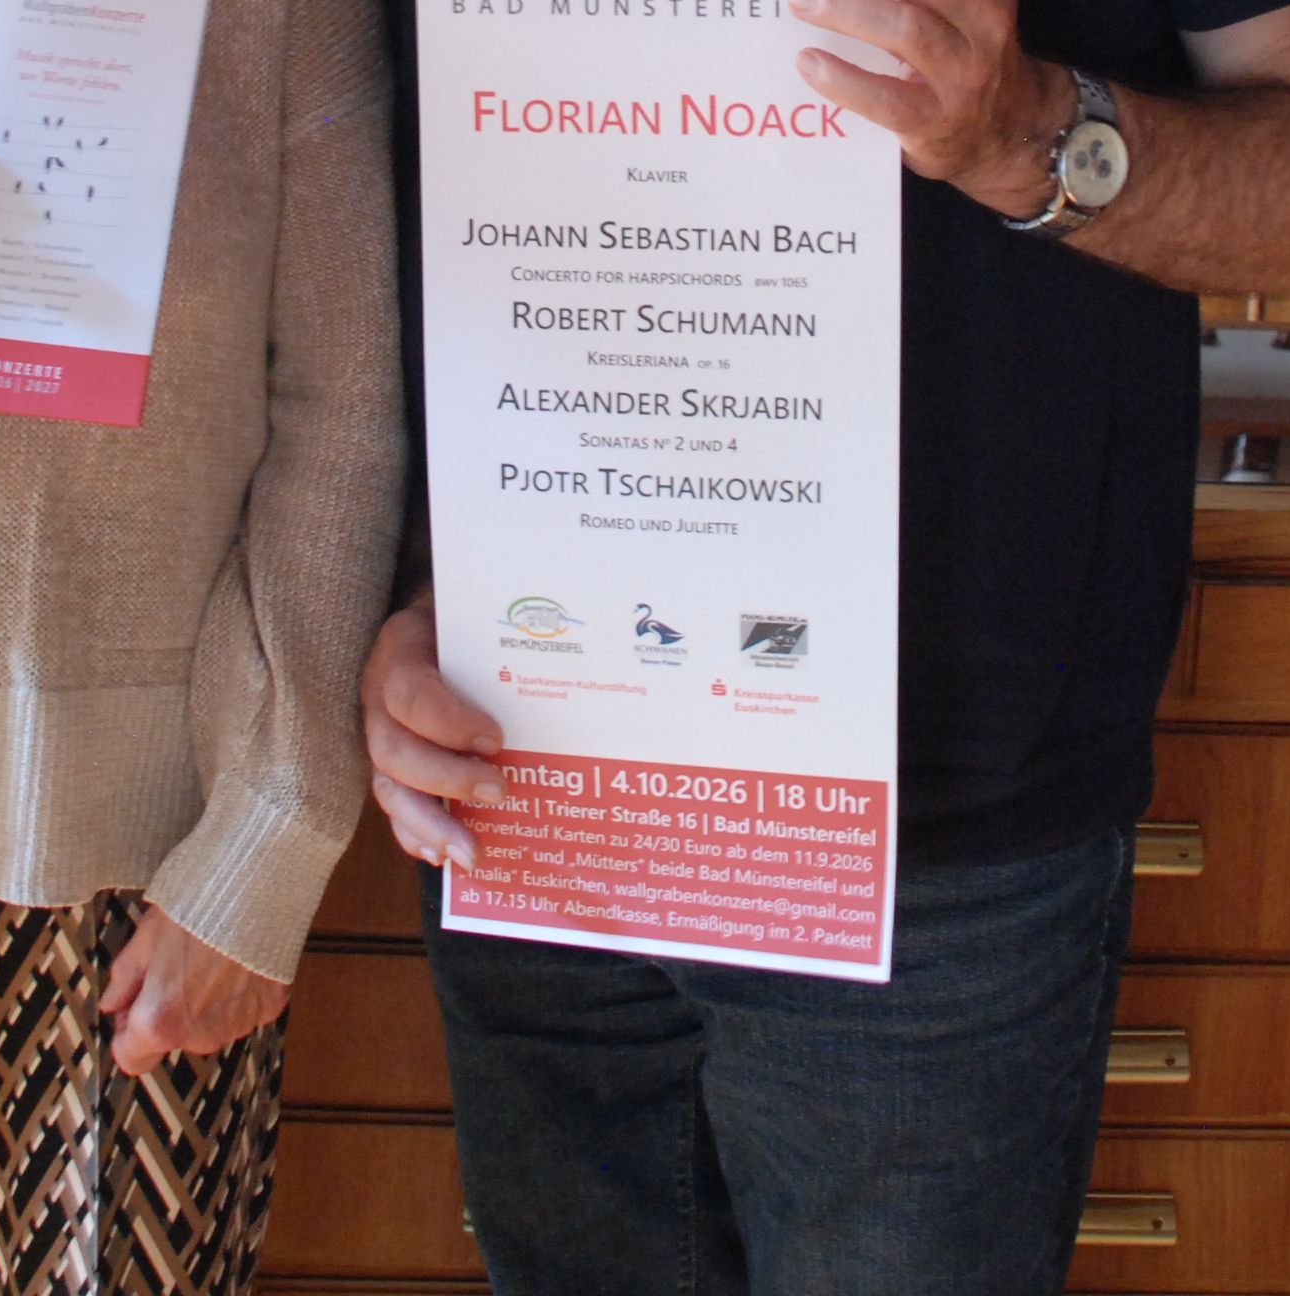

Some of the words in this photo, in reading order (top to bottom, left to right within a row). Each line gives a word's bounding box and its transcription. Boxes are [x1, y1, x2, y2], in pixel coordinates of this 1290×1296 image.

[717, 358, 731, 370] 16
[674, 436, 685, 452] 2
[727, 437, 738, 453] 4
[734, 702, 797, 716] Euskirchen
[502, 764, 584, 796] nntag
[610, 769, 748, 805] 4.10.2026
[774, 784, 806, 810] 18
[814, 786, 871, 815] Uhr
[463, 817, 550, 839] Vorverkauf
[553, 826, 606, 846] Karten
[610, 833, 629, 848] zu
[633, 833, 680, 854] 24/30
[684, 839, 722, 858] Euro
[725, 843, 747, 860] ab
[752, 845, 789, 864] dem
[794, 849, 873, 873] 11.9.2026
[544, 798, 607, 821] Trierer
[611, 805, 672, 827] Straße
[676, 812, 698, 830] 16
[713, 815, 750, 835] Bad
[755, 818, 877, 846] Münstereifel
[522, 870, 610, 895] Euskirchen,
[614, 879, 876, 923] wallgrabenkonzerte@gmail.com
[532, 849, 564, 865] und
[649, 859, 695, 879] beide
[699, 864, 730, 883] Bad
[735, 867, 837, 894] Münstereifel
[841, 881, 875, 898] und
[459, 887, 481, 904] ab
[485, 890, 526, 909] 17.15
[530, 895, 559, 913] Uhr
[563, 899, 662, 928] Abendkasse,
[666, 911, 765, 942] Ermäßigung
[769, 922, 790, 940] im
[794, 925, 809, 943] 2.
[813, 927, 873, 950] Parkett
